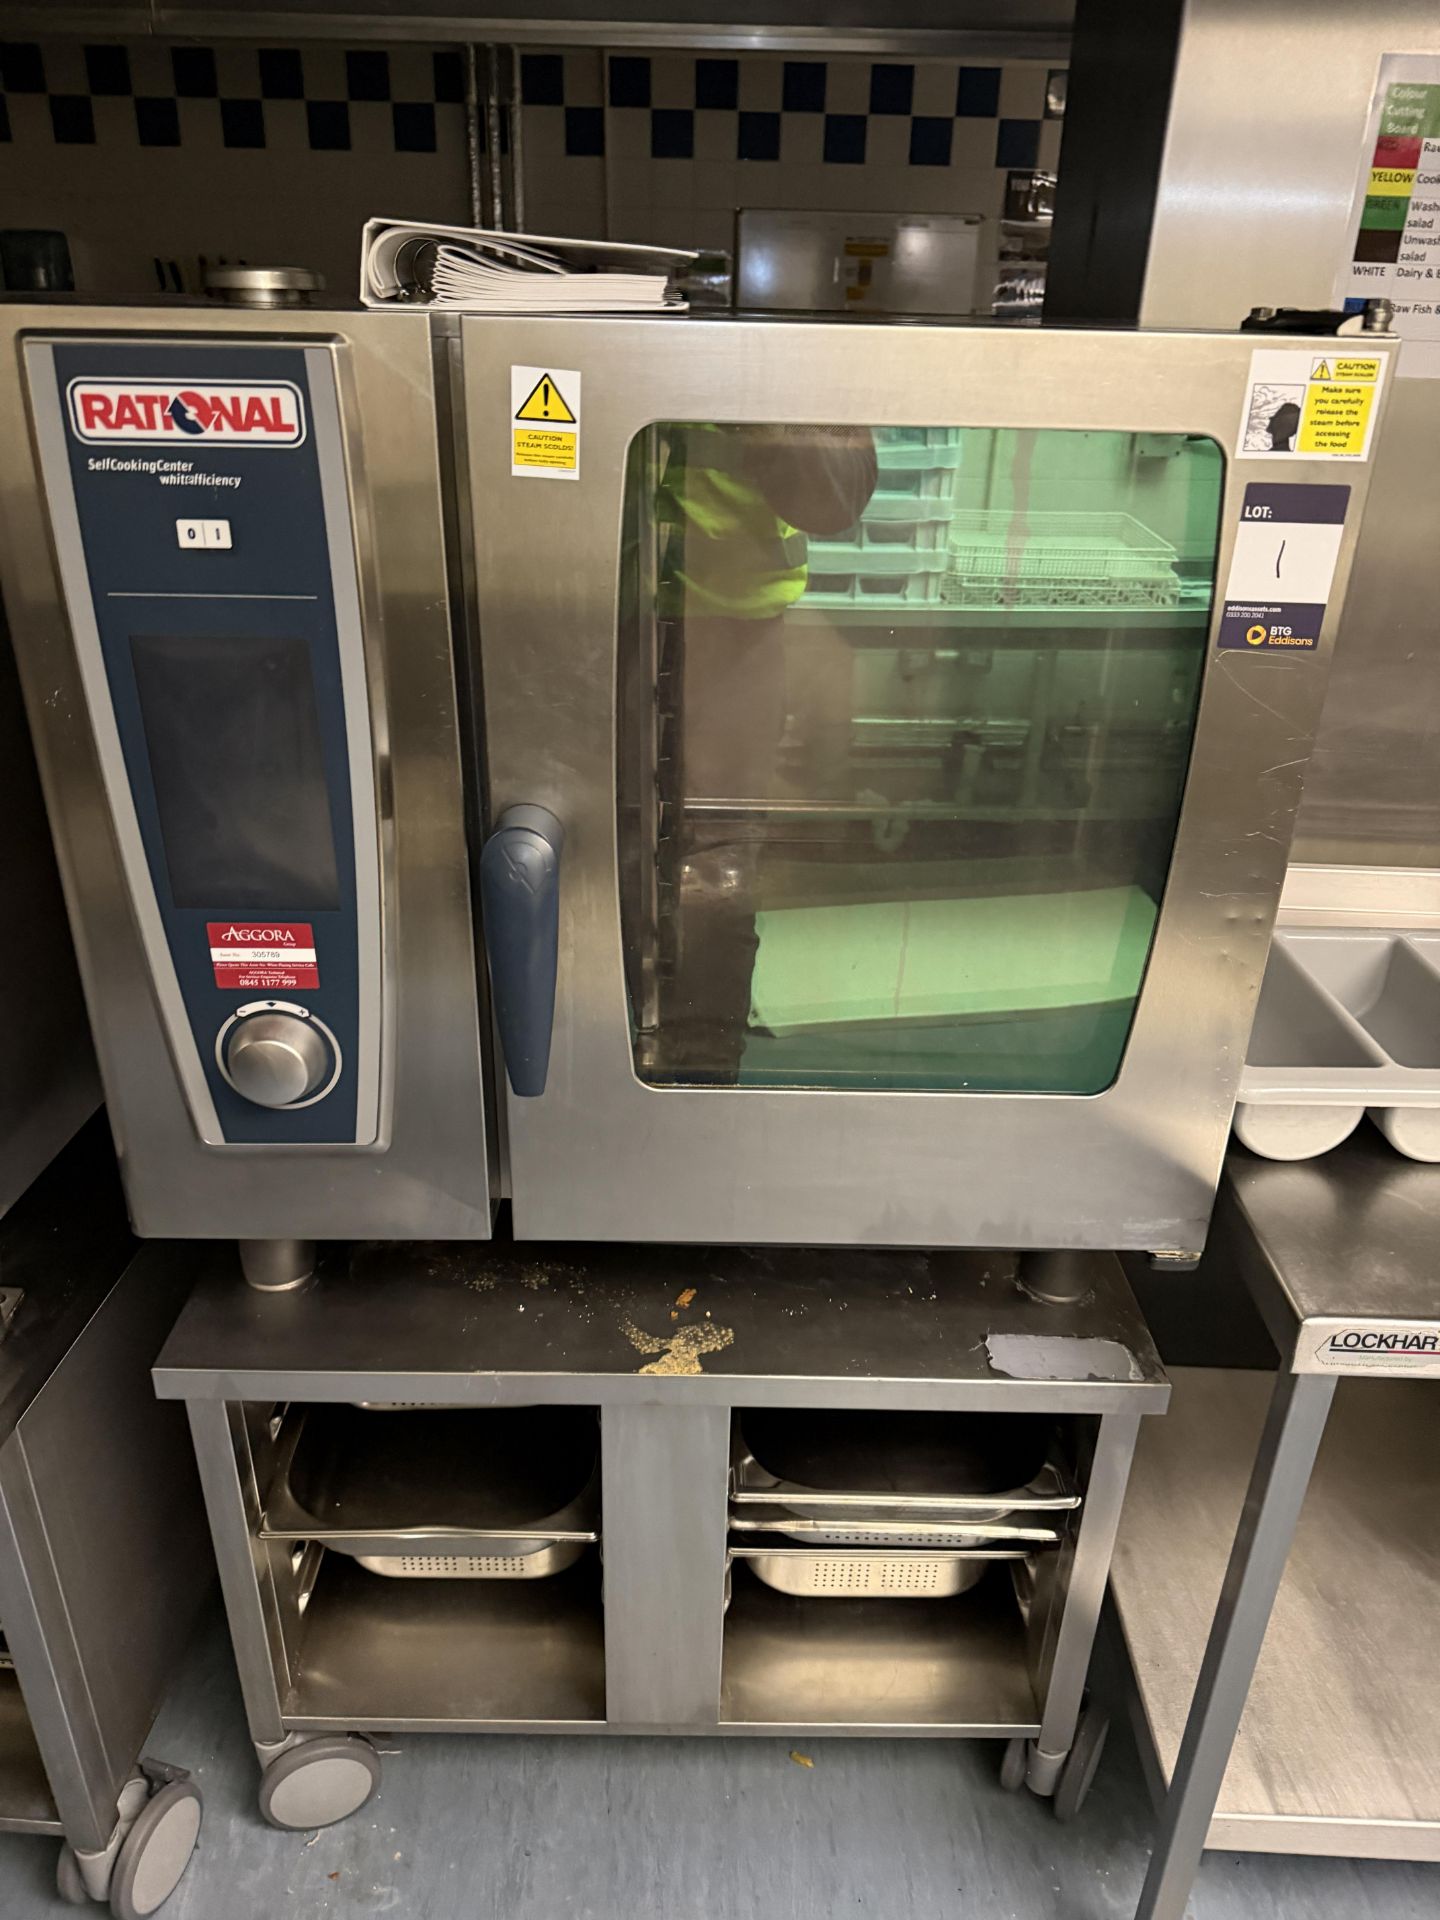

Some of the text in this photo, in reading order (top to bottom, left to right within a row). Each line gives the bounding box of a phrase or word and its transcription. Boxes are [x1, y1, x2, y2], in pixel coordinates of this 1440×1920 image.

[1386, 121, 1419, 134] Board
[1371, 171, 1414, 183] YELLOW
[1407, 217, 1434, 228] salad
[1400, 250, 1426, 262] salad
[1352, 265, 1386, 277] WHITE
[1396, 267, 1423, 280] Dairy
[1425, 268, 1433, 279] &
[1412, 303, 1432, 314] Fish
[1336, 362, 1376, 371] CAUTION
[1321, 386, 1343, 394] Make
[1330, 397, 1363, 406] carefully
[79, 390, 295, 435] RATIONAL
[1316, 408, 1358, 416] release the
[1335, 419, 1360, 427] before
[528, 434, 562, 442] CAUTION
[1315, 430, 1351, 438] accessing
[87, 457, 194, 474] SelfCookingCenter
[1245, 506, 1272, 518] LOT:
[187, 527, 196, 540] 0
[1270, 626, 1292, 635] BTG
[1268, 636, 1313, 645] Eddisons
[221, 926, 295, 942] AGGORA
[1329, 1332, 1440, 1350] LOCKHAR
